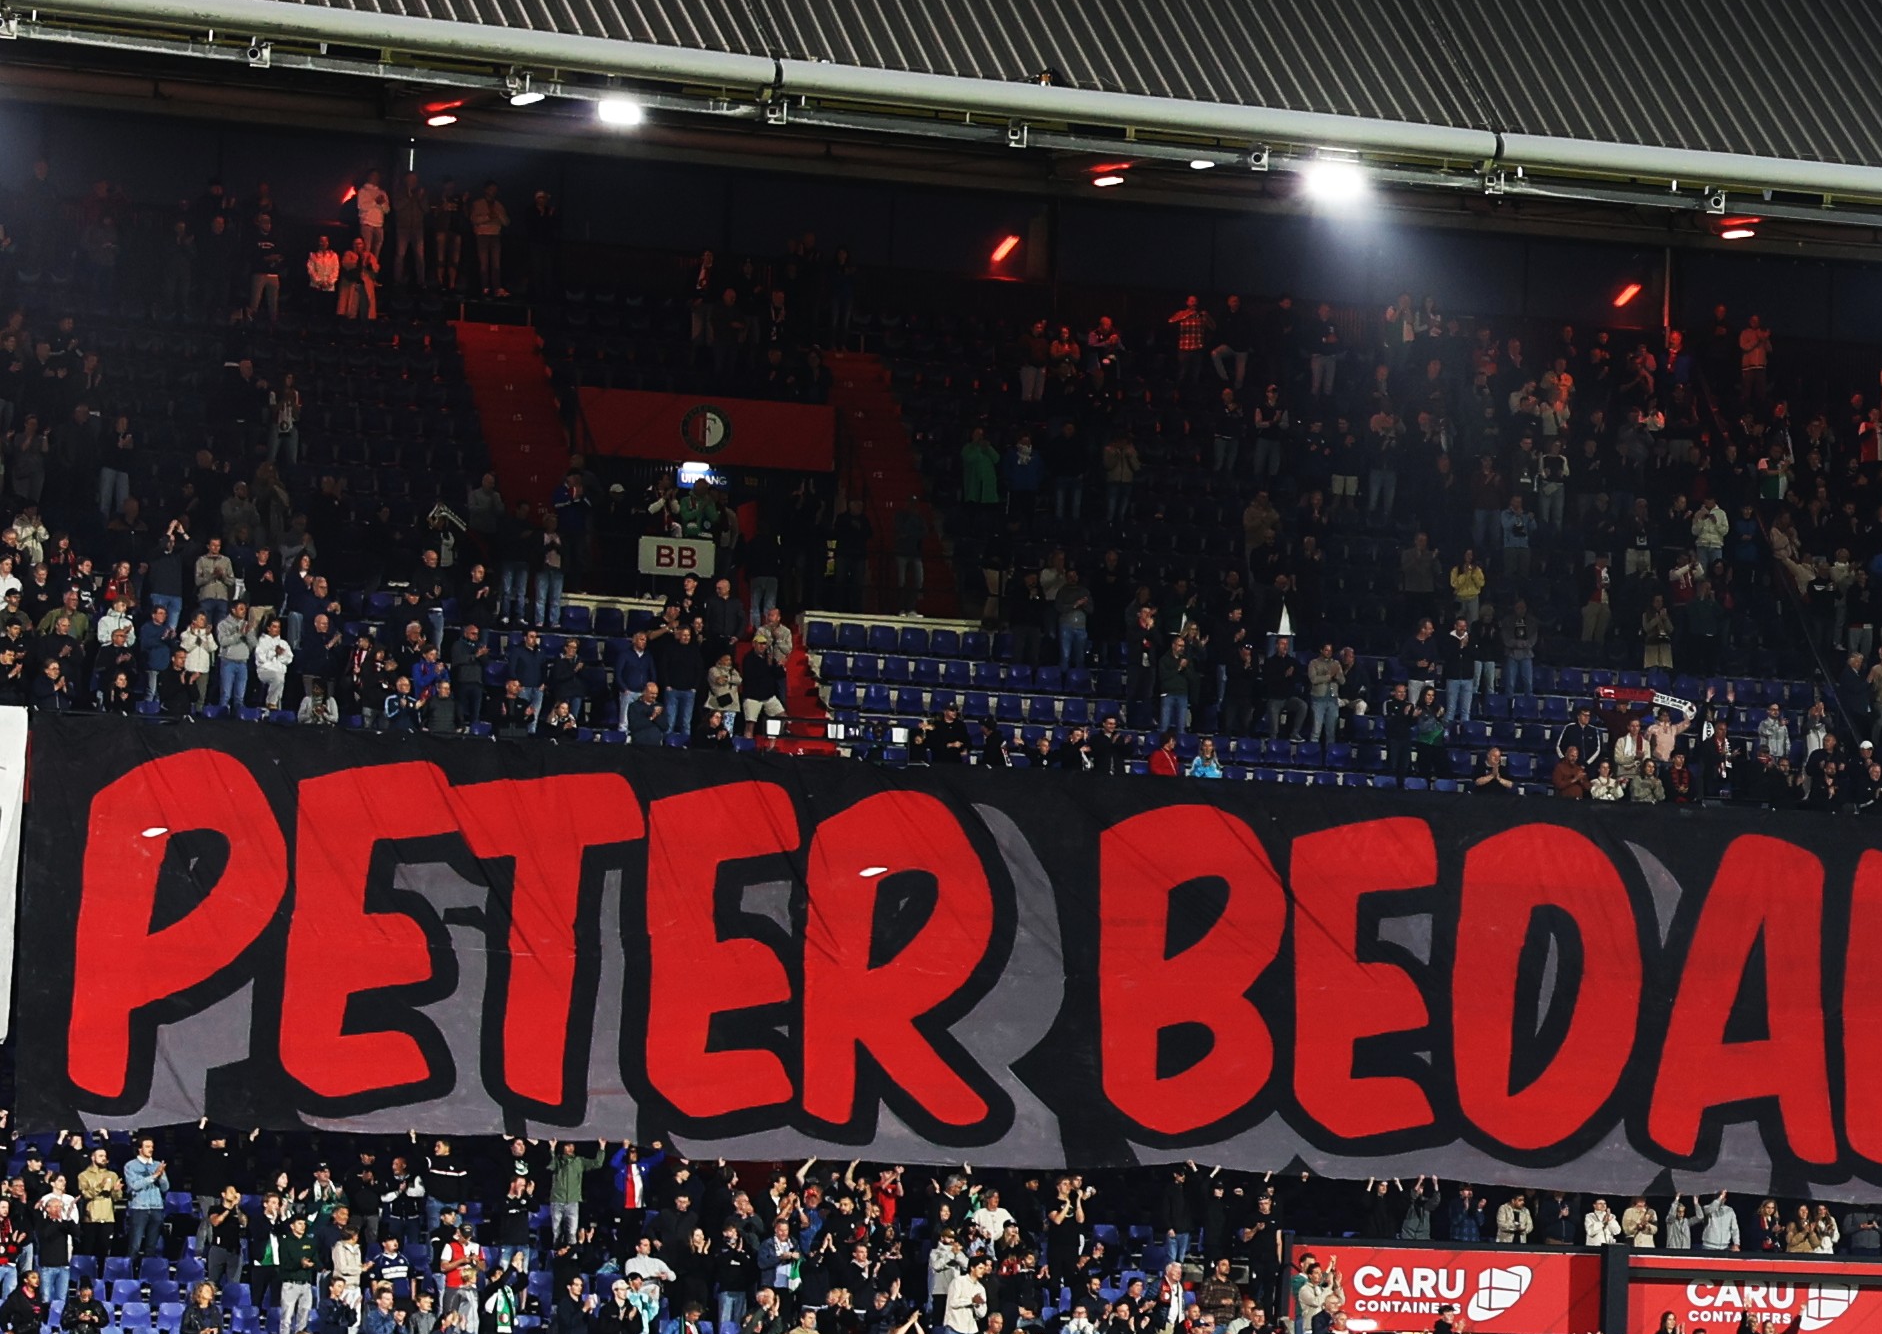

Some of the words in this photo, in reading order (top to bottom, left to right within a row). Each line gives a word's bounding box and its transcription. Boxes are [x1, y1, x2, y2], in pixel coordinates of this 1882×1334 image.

[654, 545, 697, 570] BB
[68, 749, 994, 1126] PETER
[1353, 1265, 1465, 1299] CARU
[1686, 1277, 1795, 1310] CARU
[1688, 1310, 1792, 1325] CONTAERS
